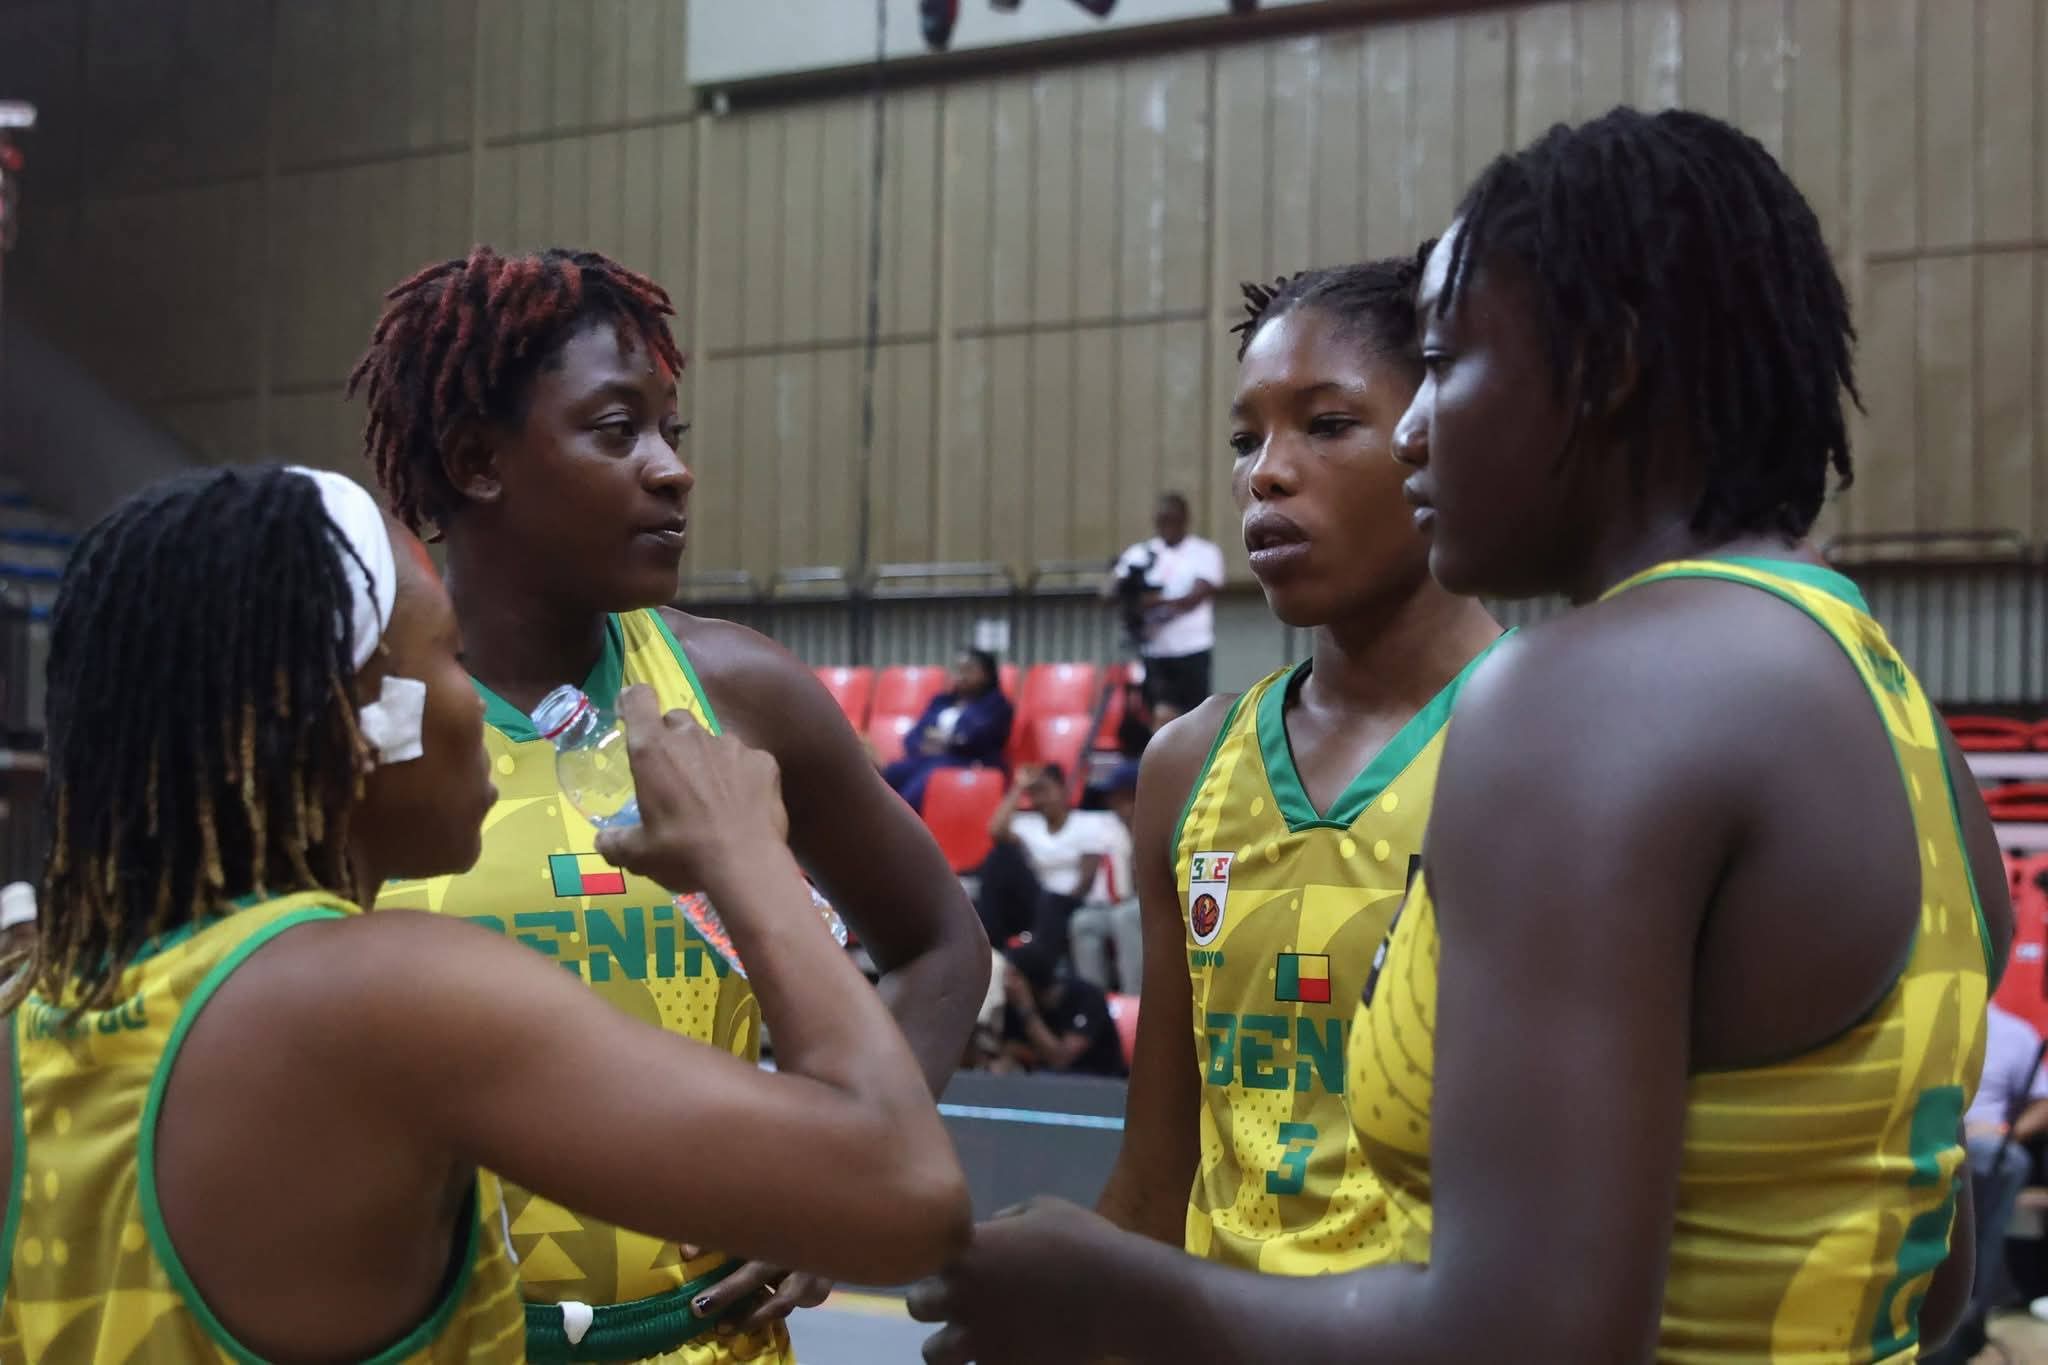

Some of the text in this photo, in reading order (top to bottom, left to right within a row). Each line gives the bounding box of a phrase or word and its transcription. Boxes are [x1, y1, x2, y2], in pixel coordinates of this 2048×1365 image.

[462, 906, 730, 982] ENi
[1206, 1013, 1352, 1094] BEN
[1265, 1122, 1318, 1195] 3
